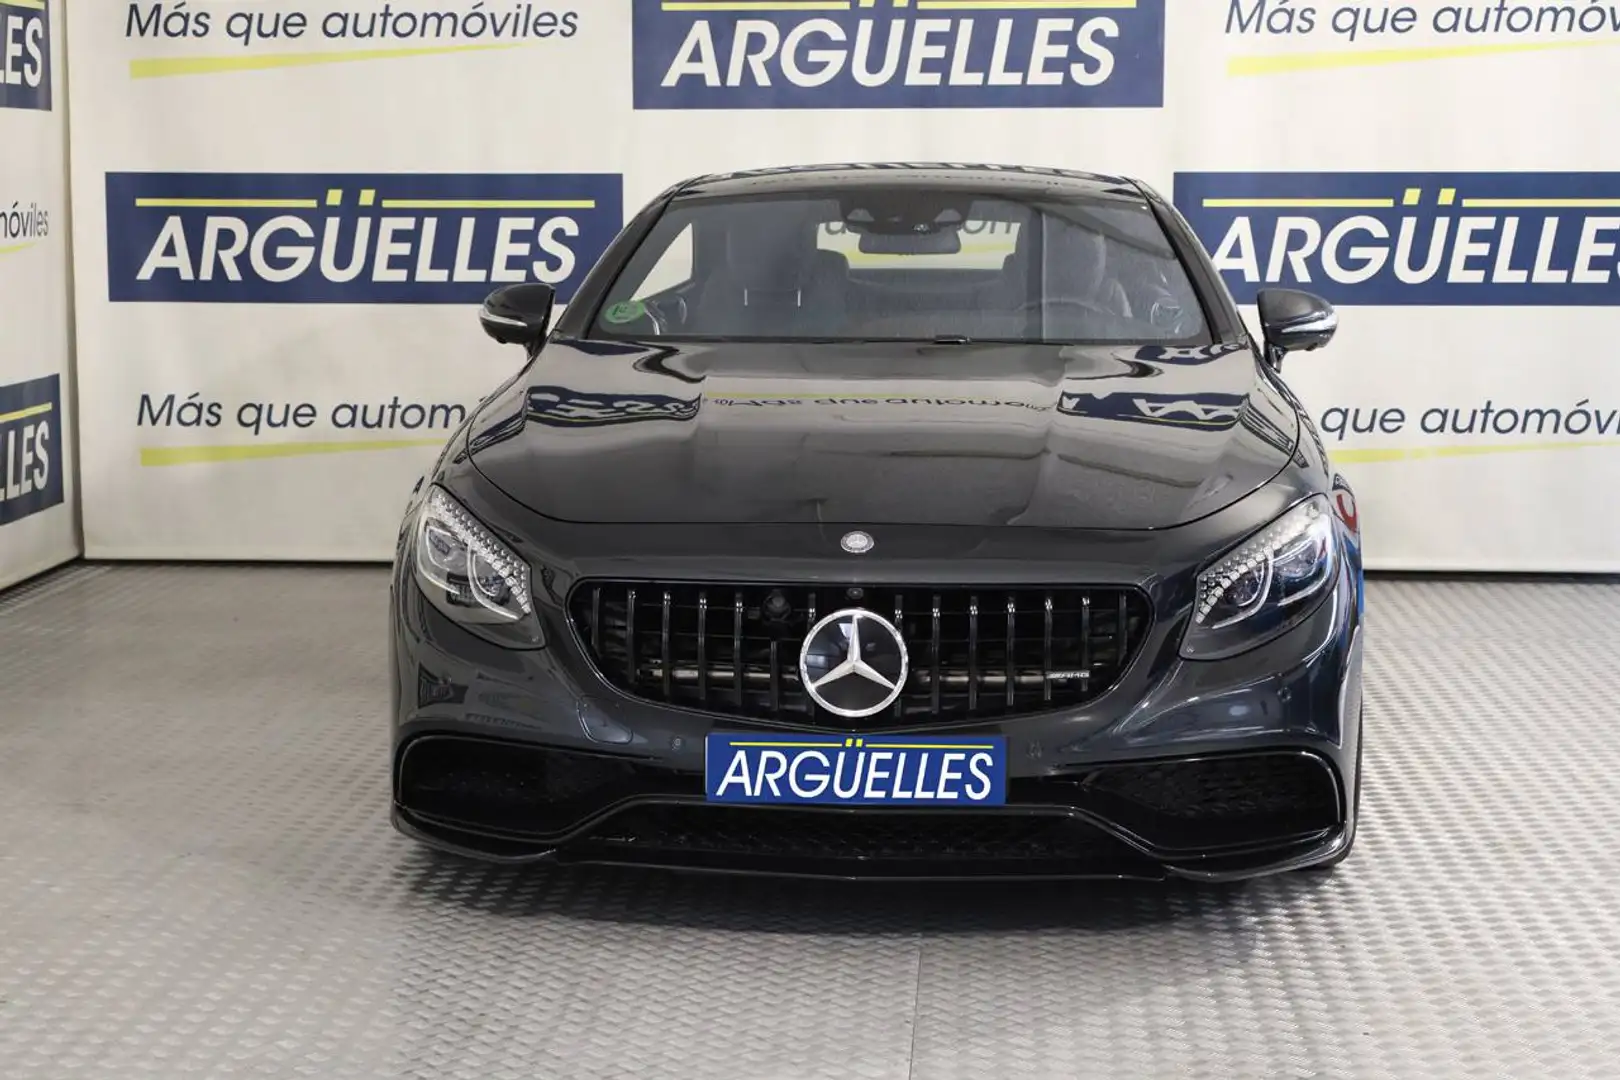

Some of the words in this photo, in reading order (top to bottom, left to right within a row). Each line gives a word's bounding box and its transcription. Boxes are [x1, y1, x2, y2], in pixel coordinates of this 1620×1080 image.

[126, 1, 211, 38] Más
[226, 12, 307, 46] que
[322, 2, 579, 38] automóviles
[1225, 0, 1315, 34] Más
[1331, 6, 1418, 42] que
[136, 188, 580, 283] ARGÜELLES
[1211, 187, 1620, 285] ARGÜELLE
[137, 392, 222, 427] Más
[237, 402, 317, 436] que
[331, 396, 468, 429] autom
[1320, 407, 1405, 441] que
[716, 738, 994, 800] ARGÜELLES
